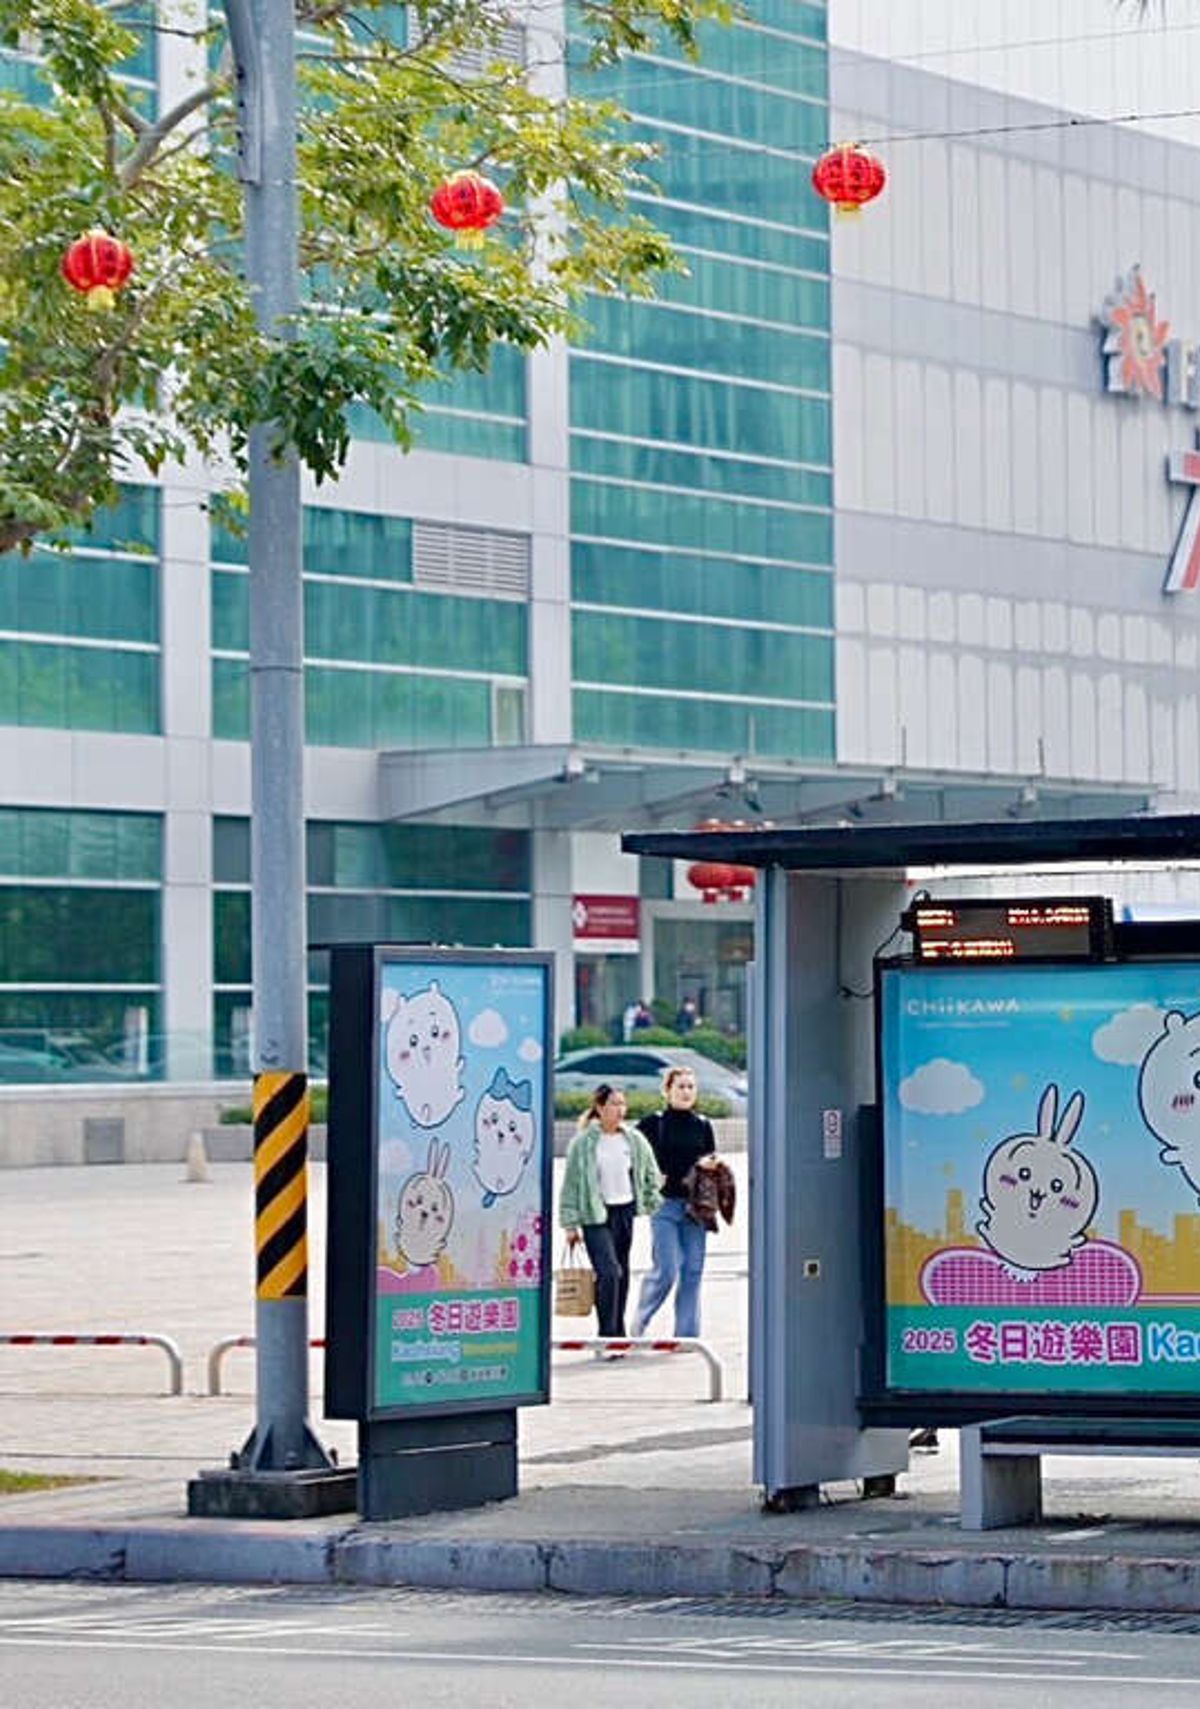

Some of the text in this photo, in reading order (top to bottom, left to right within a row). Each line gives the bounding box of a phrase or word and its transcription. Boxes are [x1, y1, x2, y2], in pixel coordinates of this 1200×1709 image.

[904, 1331, 954, 1352] 2025
[967, 1324, 1140, 1363] 冬日遊樂園
